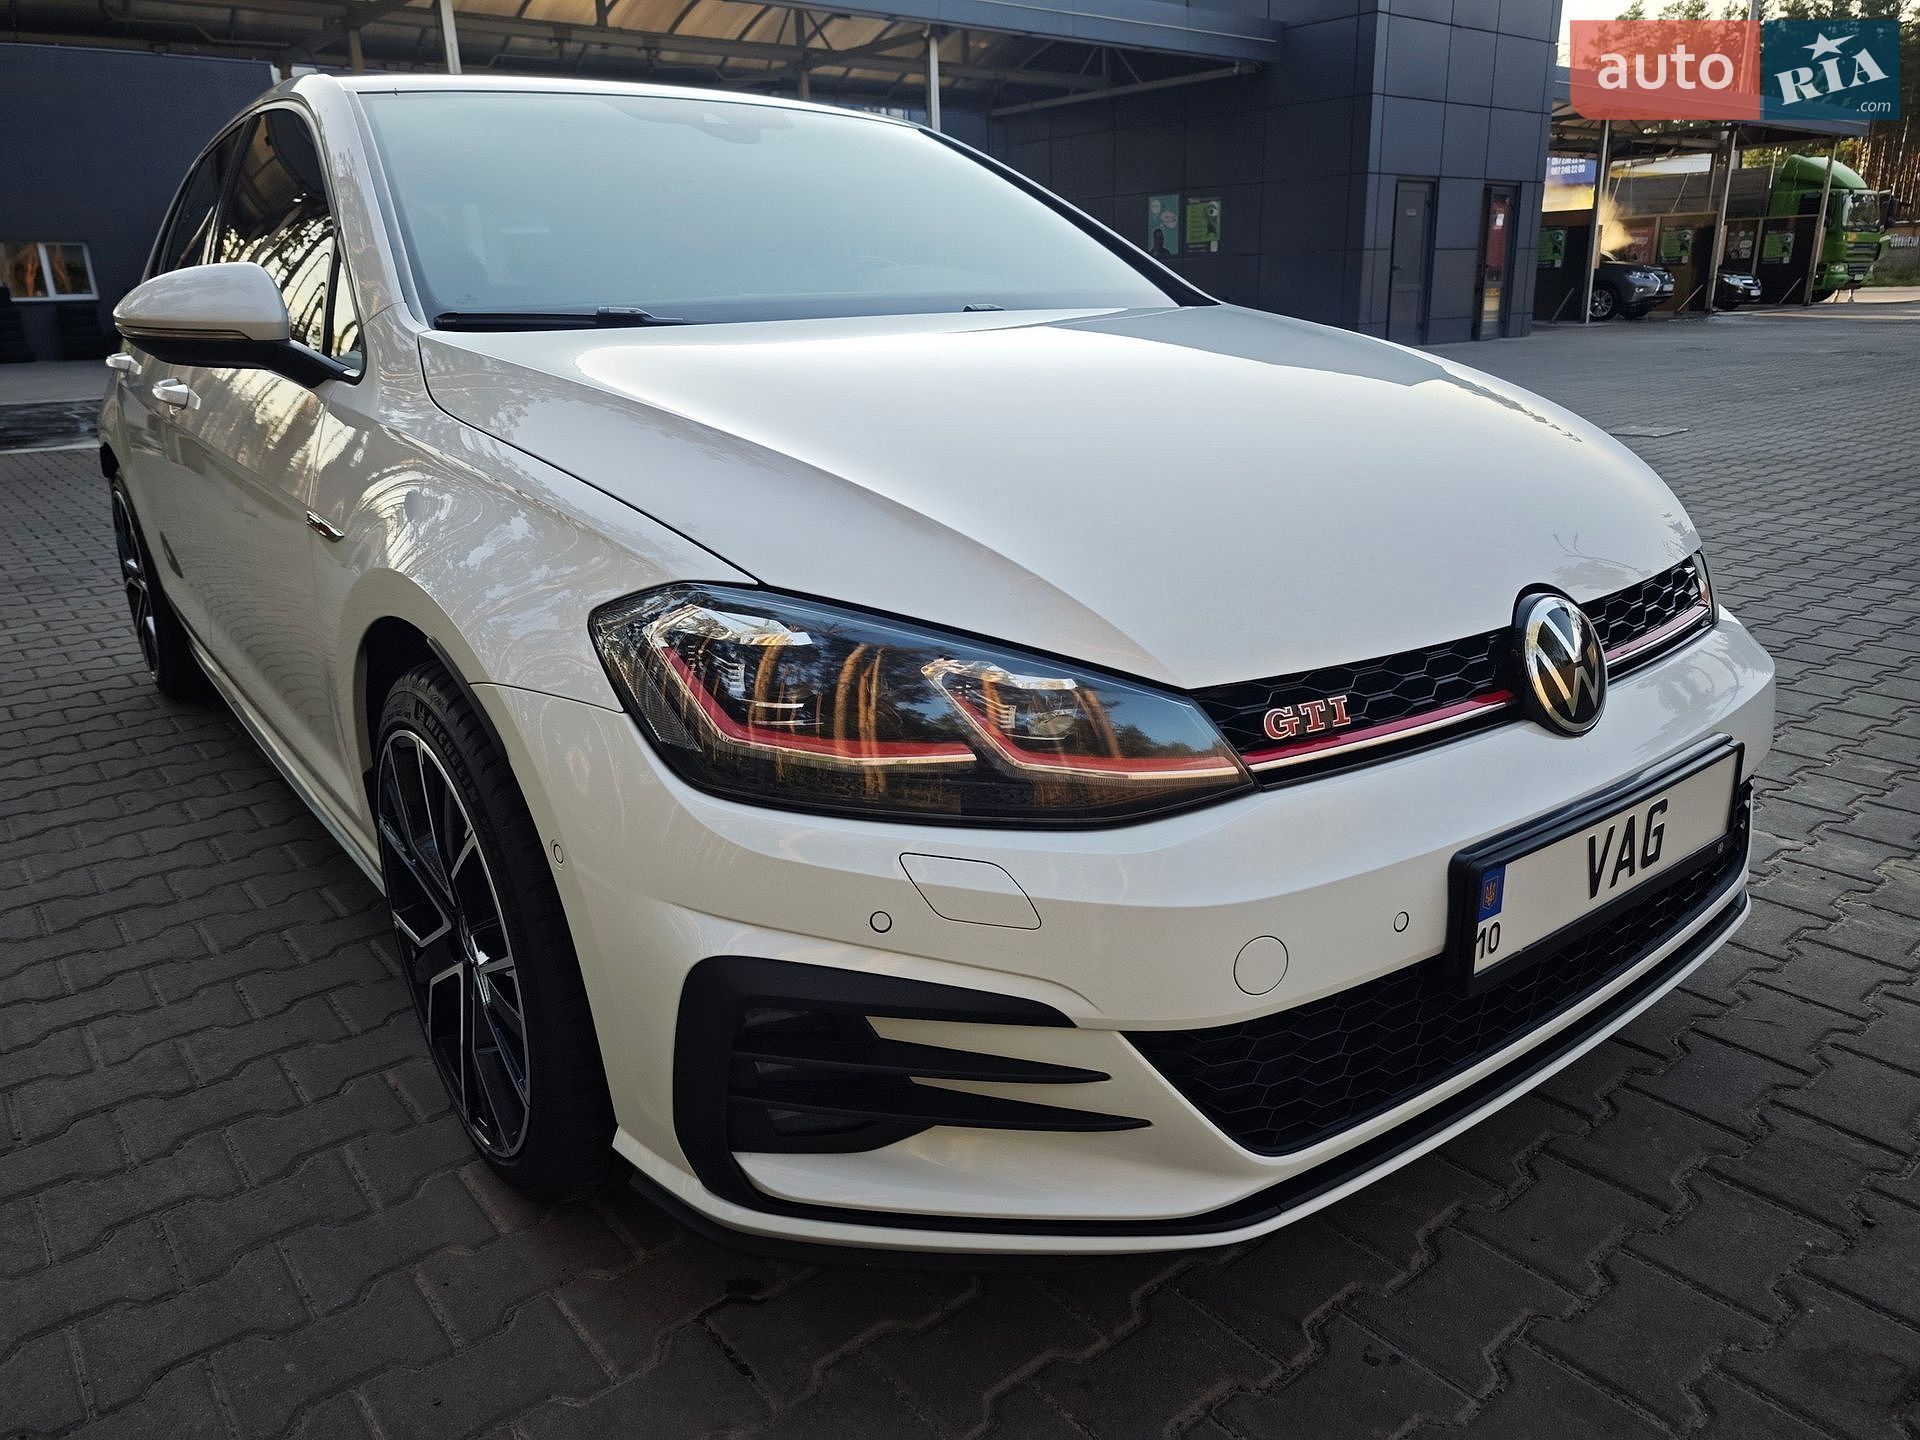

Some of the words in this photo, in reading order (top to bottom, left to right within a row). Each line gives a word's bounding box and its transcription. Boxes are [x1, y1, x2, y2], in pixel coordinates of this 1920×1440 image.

[1263, 695, 1351, 739] GTI
[426, 716, 481, 803] MICHELIN
[1588, 798, 1668, 899] VAG
[1476, 921, 1501, 959] 10
